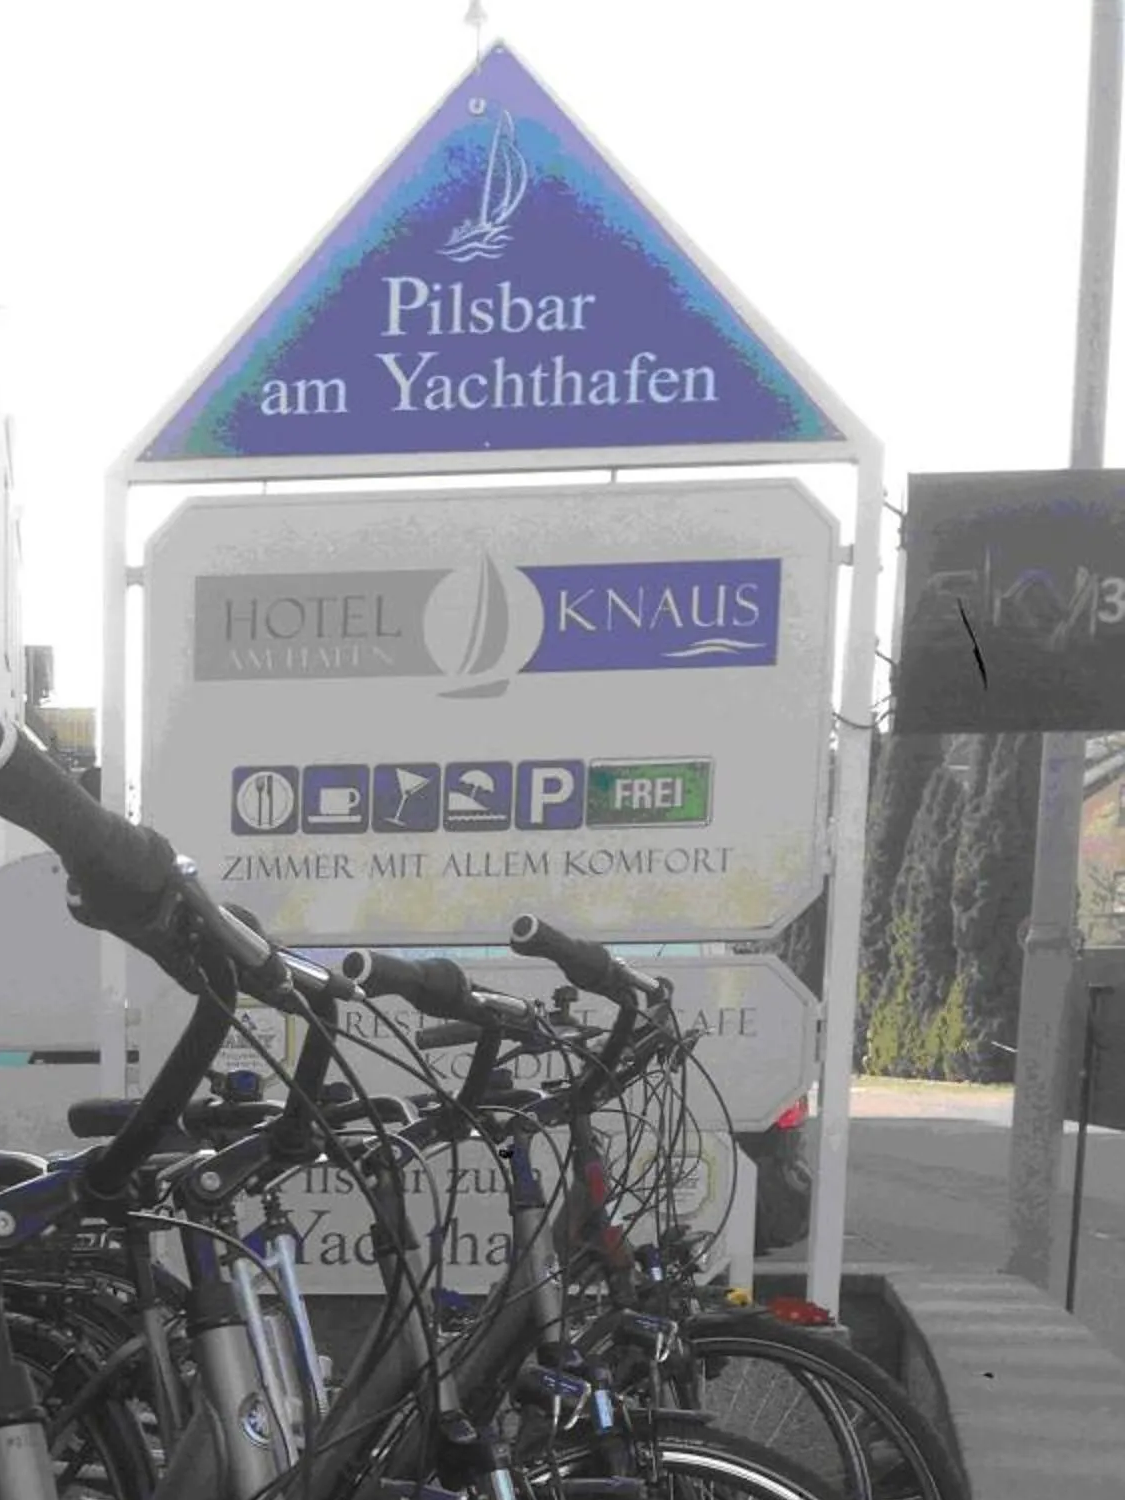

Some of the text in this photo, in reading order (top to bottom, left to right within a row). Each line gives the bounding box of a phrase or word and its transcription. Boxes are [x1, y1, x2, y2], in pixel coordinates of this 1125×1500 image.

[381, 276, 596, 337] Pilsbar
[260, 351, 718, 416] am Yachthafen
[224, 594, 402, 642] HOTEL
[558, 583, 760, 632] KNAUS
[613, 777, 684, 811] FREI
[222, 846, 732, 881] ZIMMER MIT ALLEM KOMFORT
